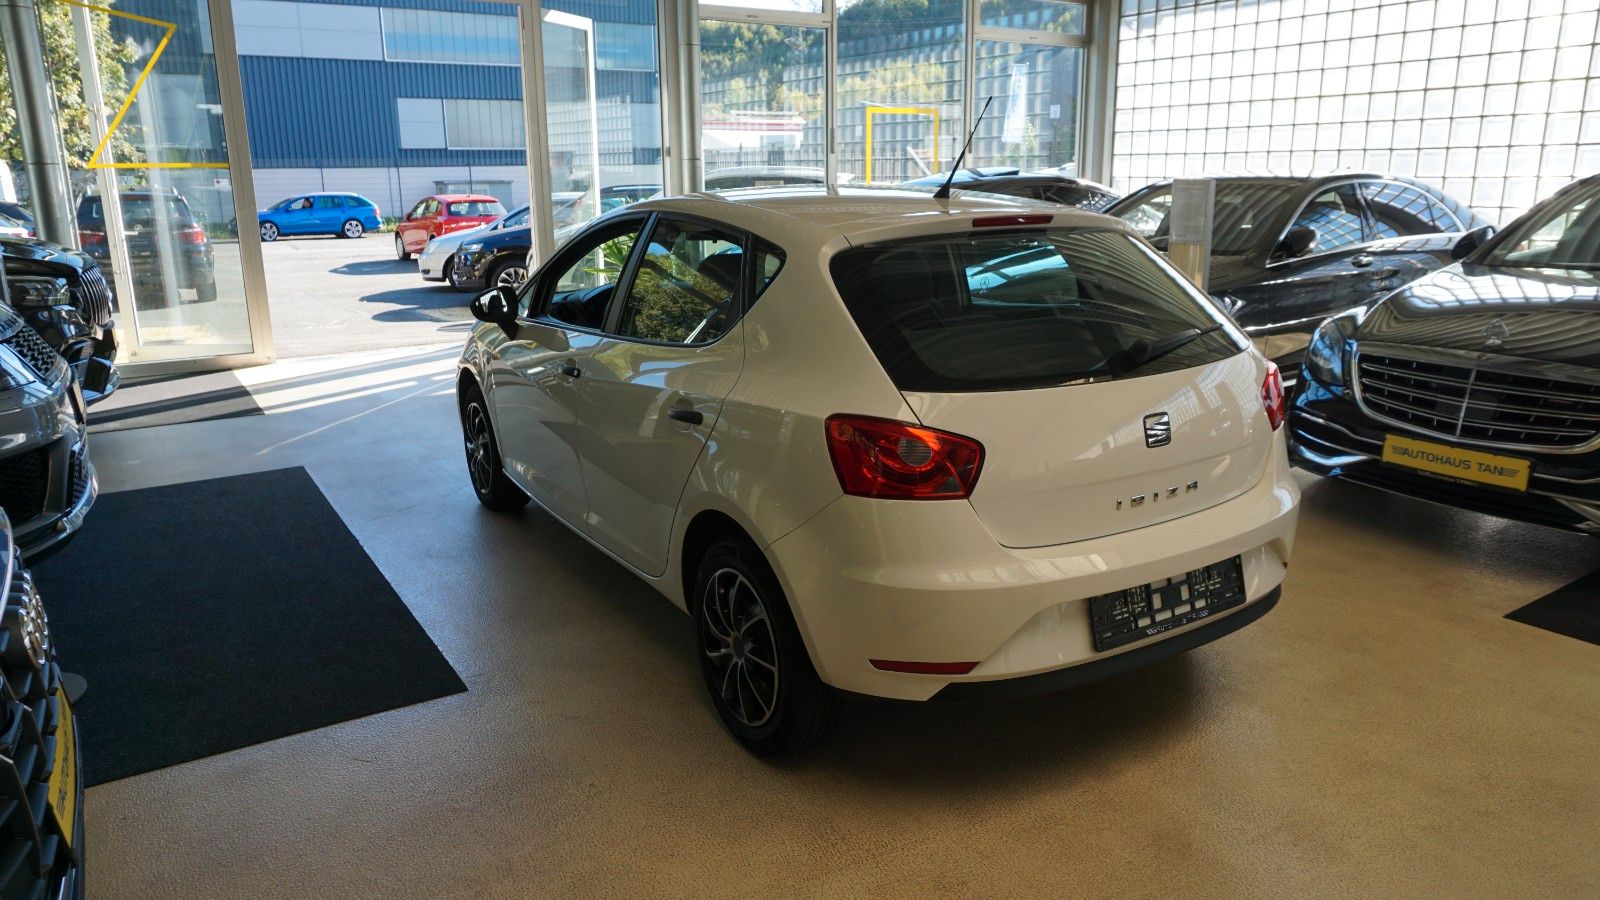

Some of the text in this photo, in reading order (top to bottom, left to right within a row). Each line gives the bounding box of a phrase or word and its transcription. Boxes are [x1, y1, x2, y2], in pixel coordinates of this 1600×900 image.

[1403, 448, 1504, 475] AUTOHAUS TAN
[1116, 481, 1199, 511] IBIZA
